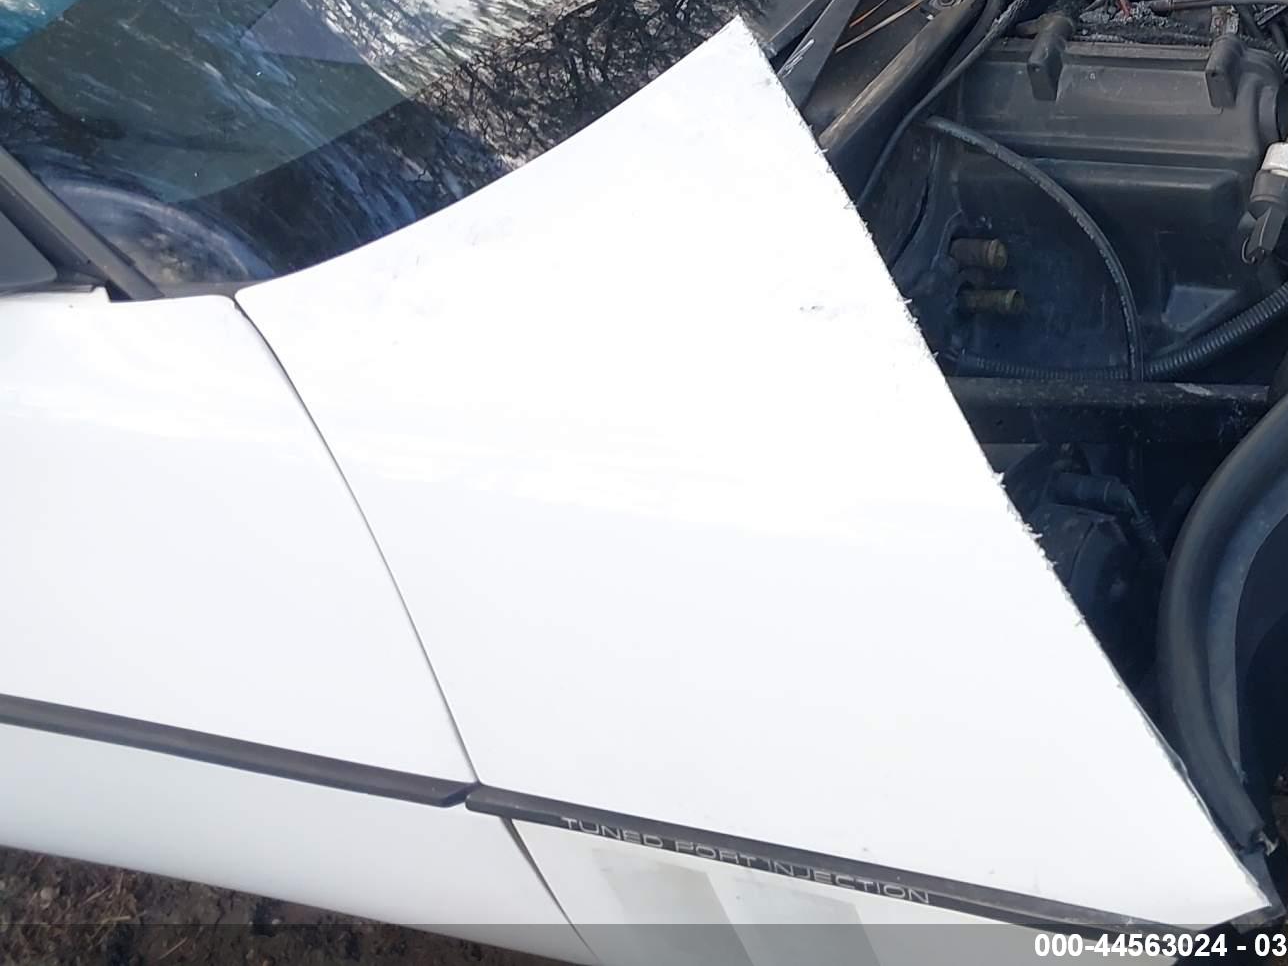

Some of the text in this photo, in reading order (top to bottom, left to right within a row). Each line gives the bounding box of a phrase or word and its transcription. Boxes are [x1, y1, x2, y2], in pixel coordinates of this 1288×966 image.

[561, 816, 930, 904] TUNED PORT INJECTION
